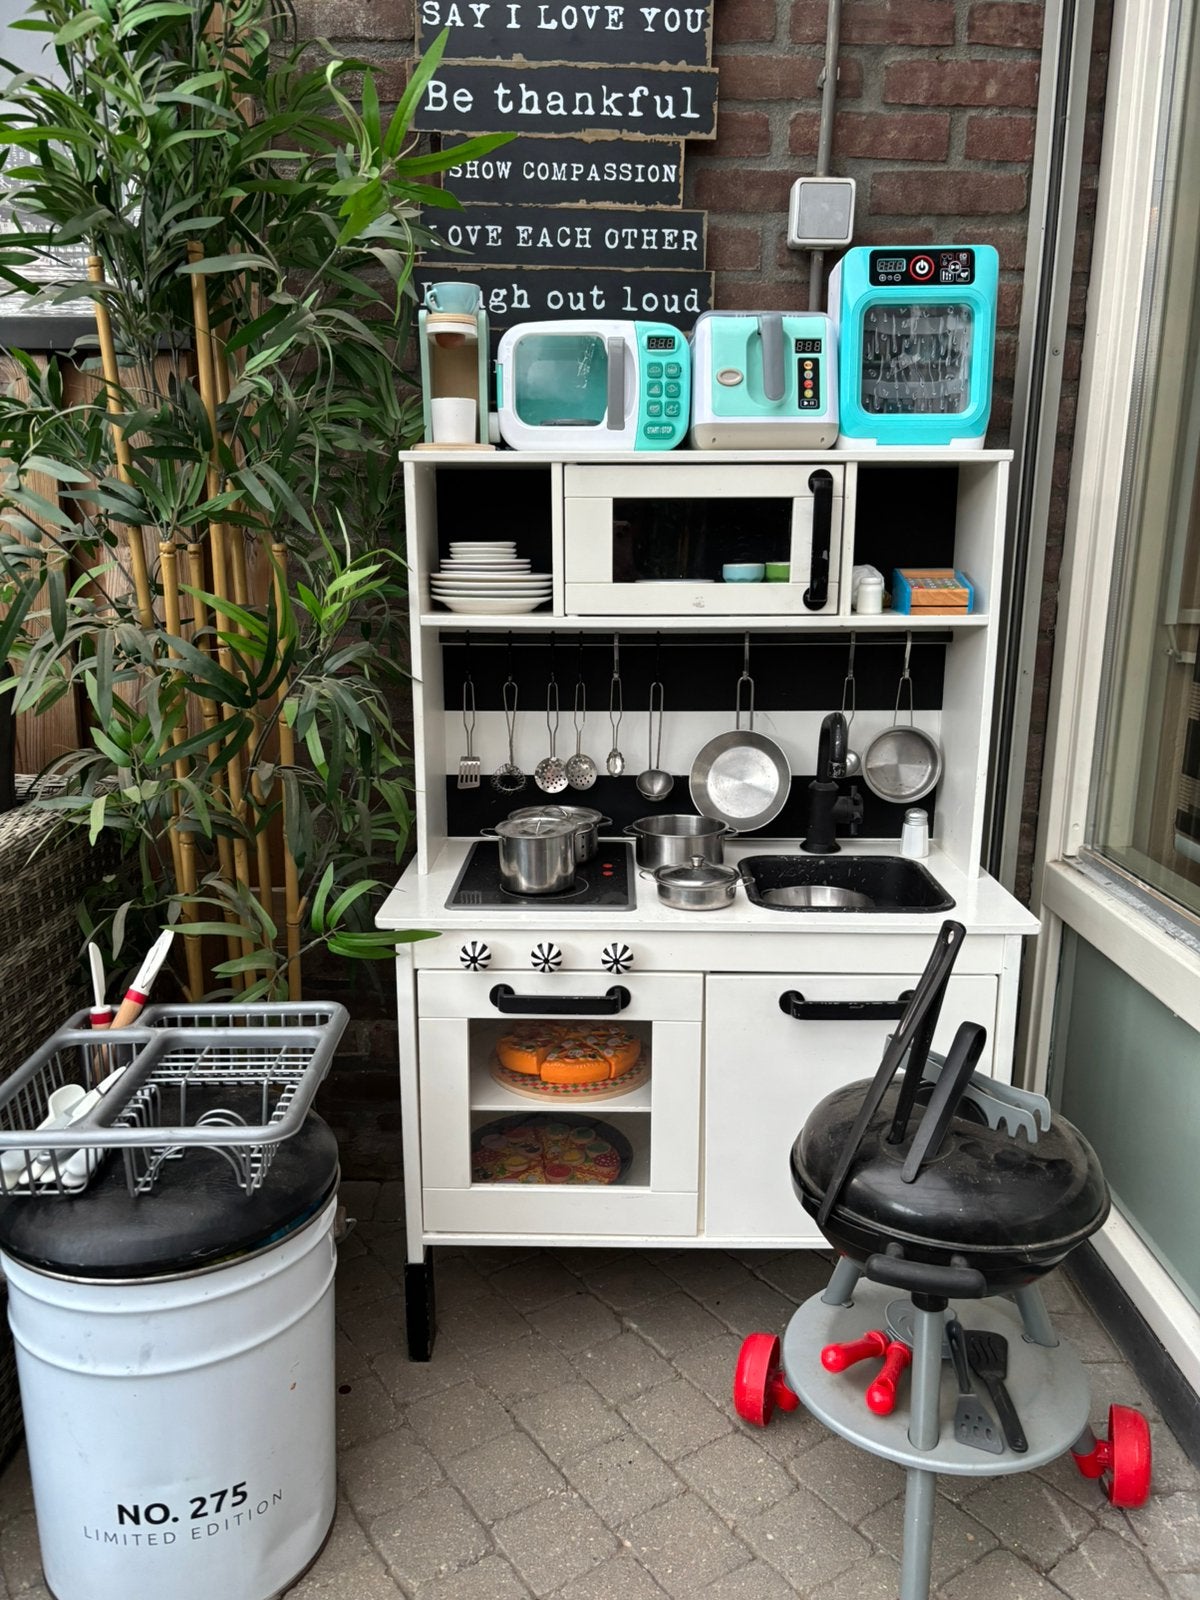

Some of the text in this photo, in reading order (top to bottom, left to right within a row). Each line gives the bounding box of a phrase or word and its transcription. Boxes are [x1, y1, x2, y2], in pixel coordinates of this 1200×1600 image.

[422, 0, 706, 33] SAY I LOVE YOU
[424, 80, 700, 119] Be thankful
[449, 160, 678, 183] SHOW COMPASSION
[515, 225, 592, 249] EACH
[604, 228, 698, 251] OTHER
[547, 285, 606, 310] out
[622, 286, 701, 313] loud
[84, 1489, 283, 1546] LIMITED EDITION
[117, 1481, 248, 1526] NO. 275
